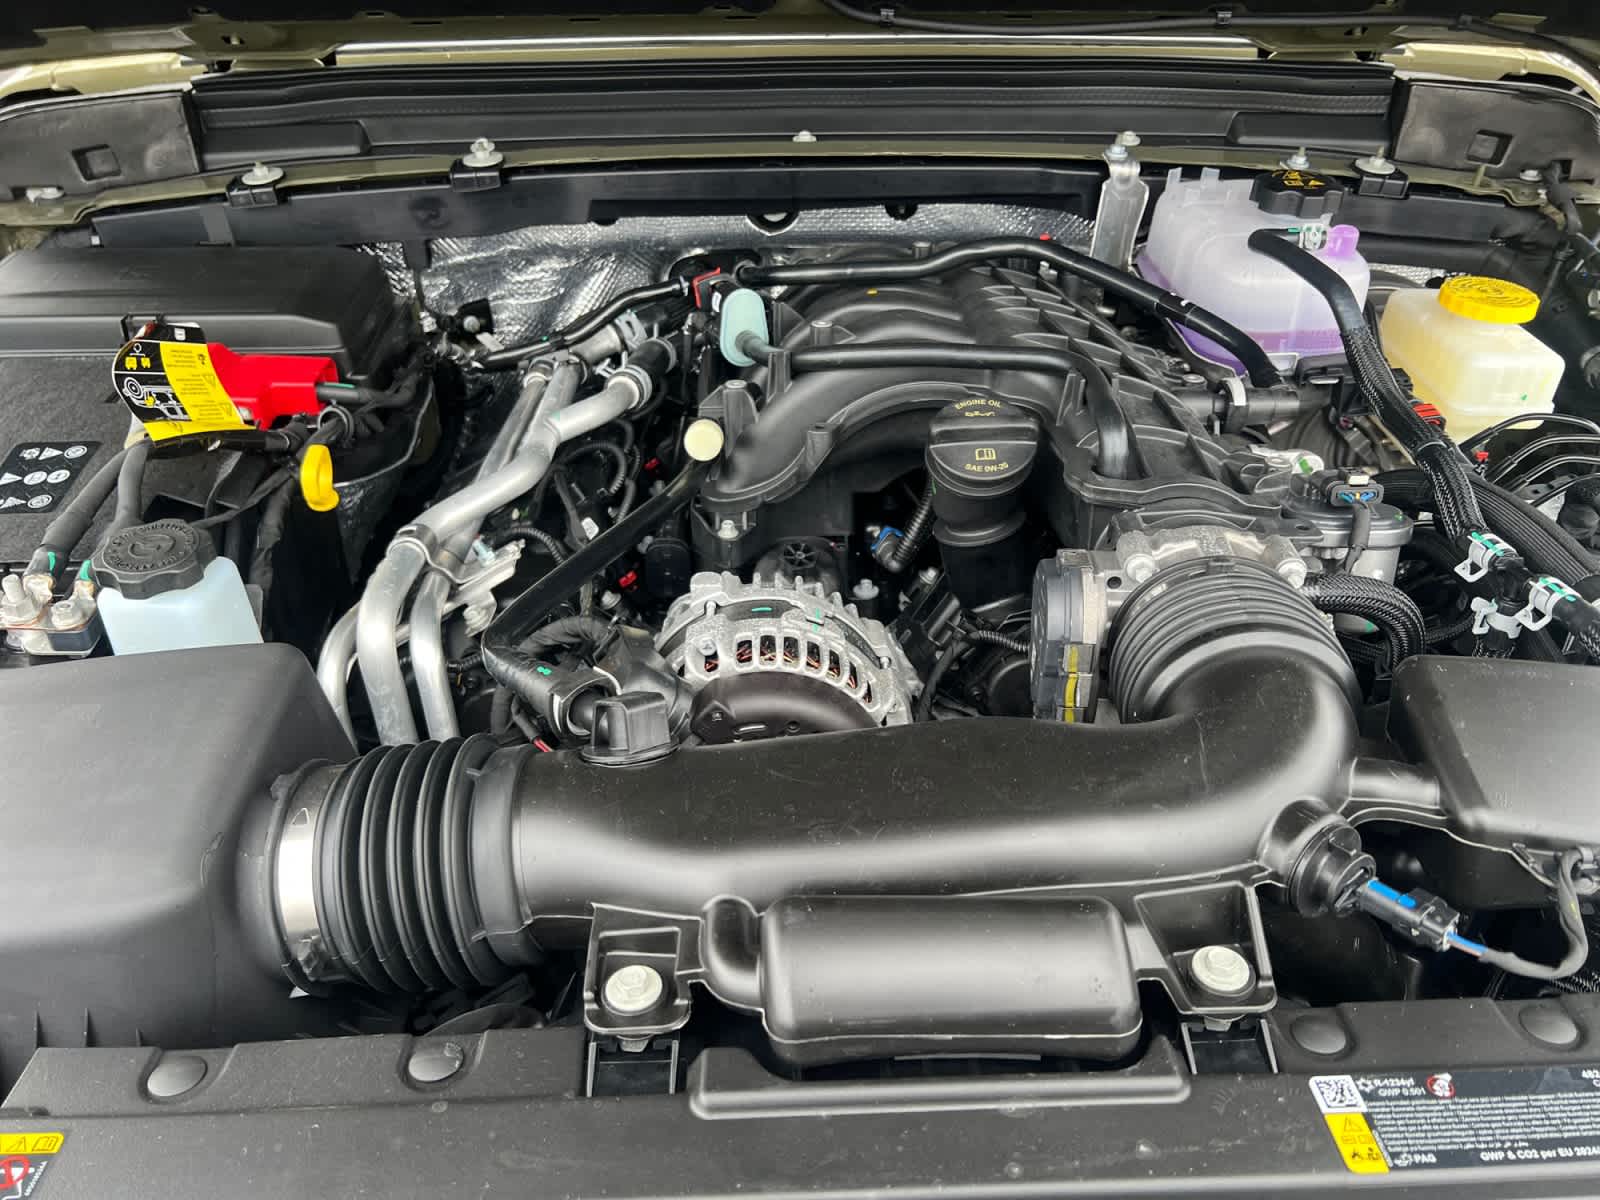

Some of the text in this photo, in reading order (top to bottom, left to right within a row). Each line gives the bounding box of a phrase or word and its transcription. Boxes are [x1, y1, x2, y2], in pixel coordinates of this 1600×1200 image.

[955, 399, 1001, 410] ENGINE OIL
[965, 463, 983, 472] SAE
[1413, 1153, 1437, 1163] PAG
[1480, 1151, 1505, 1160] GWP
[1517, 1149, 1539, 1159] CO2
[1557, 1147, 1574, 1157] EU
